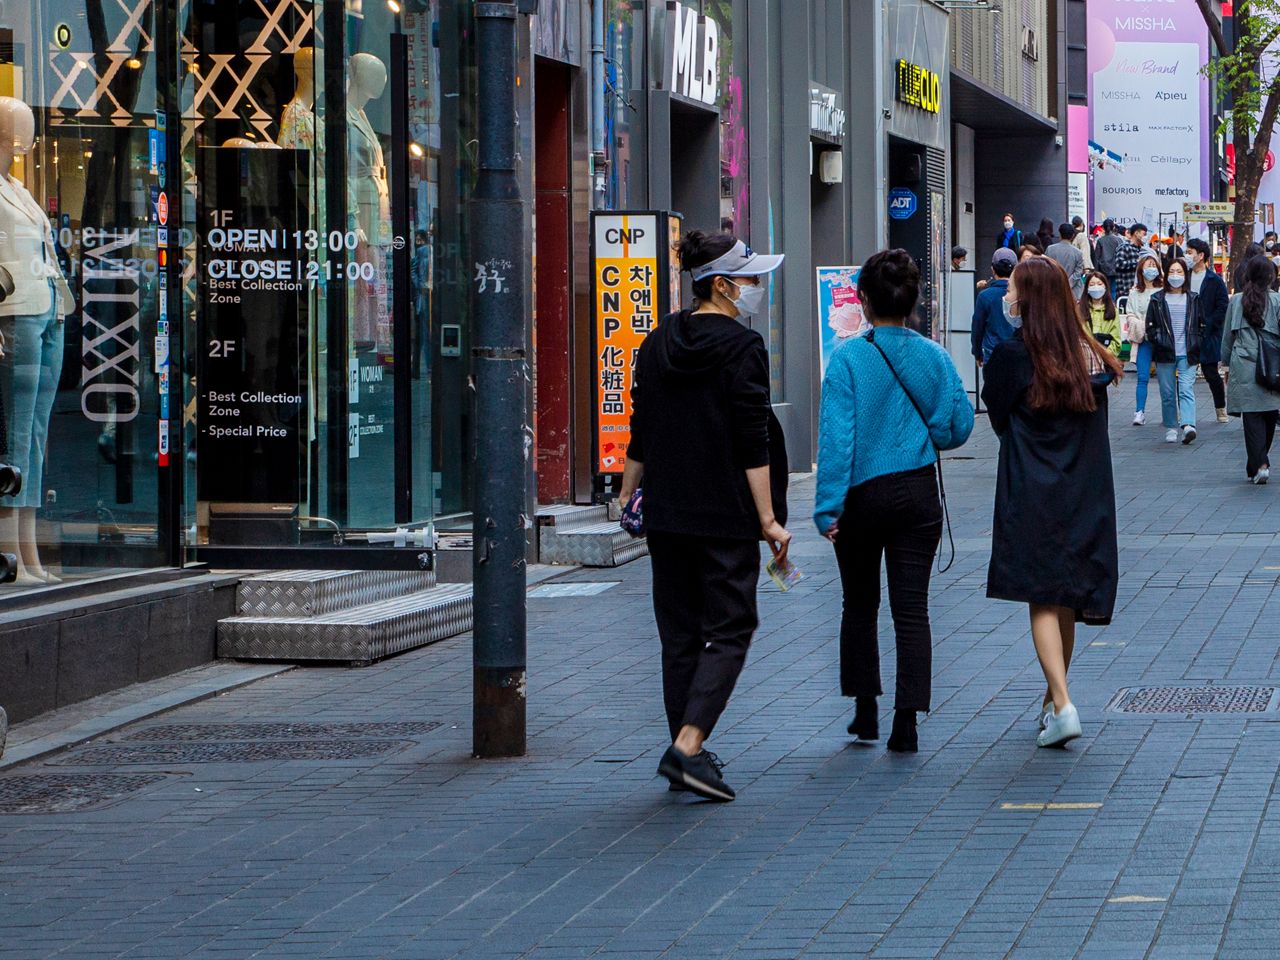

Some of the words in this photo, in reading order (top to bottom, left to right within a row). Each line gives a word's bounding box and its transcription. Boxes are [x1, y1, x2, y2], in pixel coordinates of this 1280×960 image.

[1115, 17, 1176, 31] MISSHA
[671, 1, 718, 105] MLB
[1116, 60, 1138, 74] New
[1141, 60, 1179, 75] Brand
[1101, 91, 1141, 100] MISSHA
[1104, 123, 1139, 132] stila
[1102, 187, 1142, 195] BOURJOIS
[891, 198, 912, 208] ADT
[210, 210, 233, 227] 1F
[207, 229, 277, 249] OPEN
[293, 231, 359, 252] 13:00
[605, 228, 645, 244] CNP
[208, 260, 291, 279] CLOSE
[306, 262, 375, 281] 21:00
[209, 279, 236, 289] Best
[241, 279, 303, 291] Collection
[210, 293, 241, 304] Zone
[602, 266, 620, 339] CNP
[81, 228, 140, 422] MIXXO
[209, 340, 236, 357] 2F
[360, 366, 383, 382] WOMAN
[601, 346, 624, 415] 化粧品
[209, 392, 236, 402] Best
[240, 392, 302, 403] Collection
[209, 406, 240, 416] Zone
[209, 426, 252, 438] Special
[257, 426, 287, 437] Price
